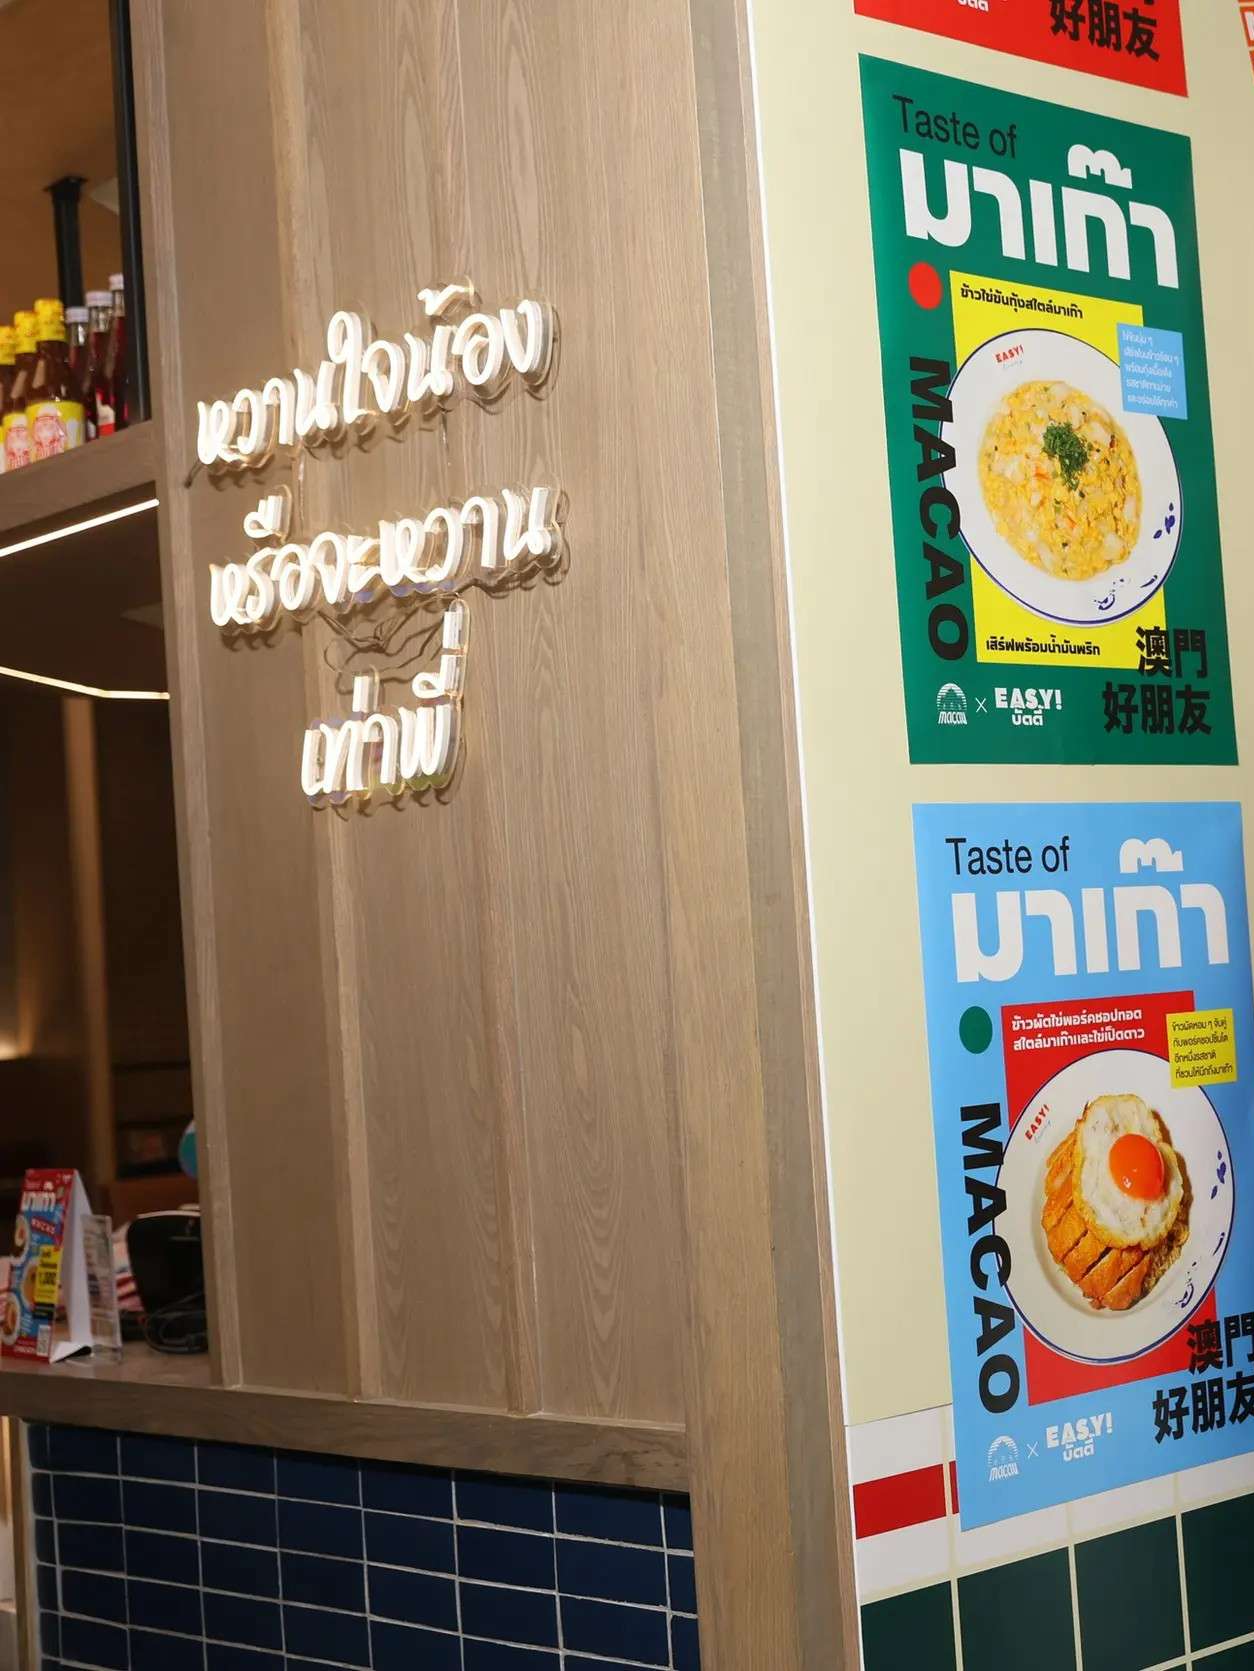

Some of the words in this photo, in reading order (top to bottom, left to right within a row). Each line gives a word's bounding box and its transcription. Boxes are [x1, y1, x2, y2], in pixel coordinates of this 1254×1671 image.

[1050, 0, 1160, 62] 好朋友
[893, 94, 980, 150] Taste
[989, 122, 1018, 159] of
[899, 143, 1180, 289] มาเก๊า
[960, 283, 1084, 319] ข้าวไข่ข้นกุ้งสไตล์มาเก๊า
[197, 283, 546, 465] หวานใจน้อง
[995, 344, 1024, 363] EASY!
[909, 356, 969, 661] MACAO
[209, 486, 552, 627] หรือจะหวาน
[986, 634, 1101, 656] เสิร์ฟพร้อมน้ำมันพริก
[1135, 626, 1208, 679] 澳門
[301, 608, 464, 796] เท่าพี่
[994, 687, 1062, 710] EASY!
[1102, 682, 1213, 735] 好朋友
[945, 837, 1032, 876] Taste
[1041, 835, 1070, 874] of
[950, 838, 1230, 983] มาเก๊า
[1025, 1104, 1050, 1141] EASY!
[960, 1102, 1020, 1414] MACAO
[1046, 1412, 1112, 1449] EASY!
